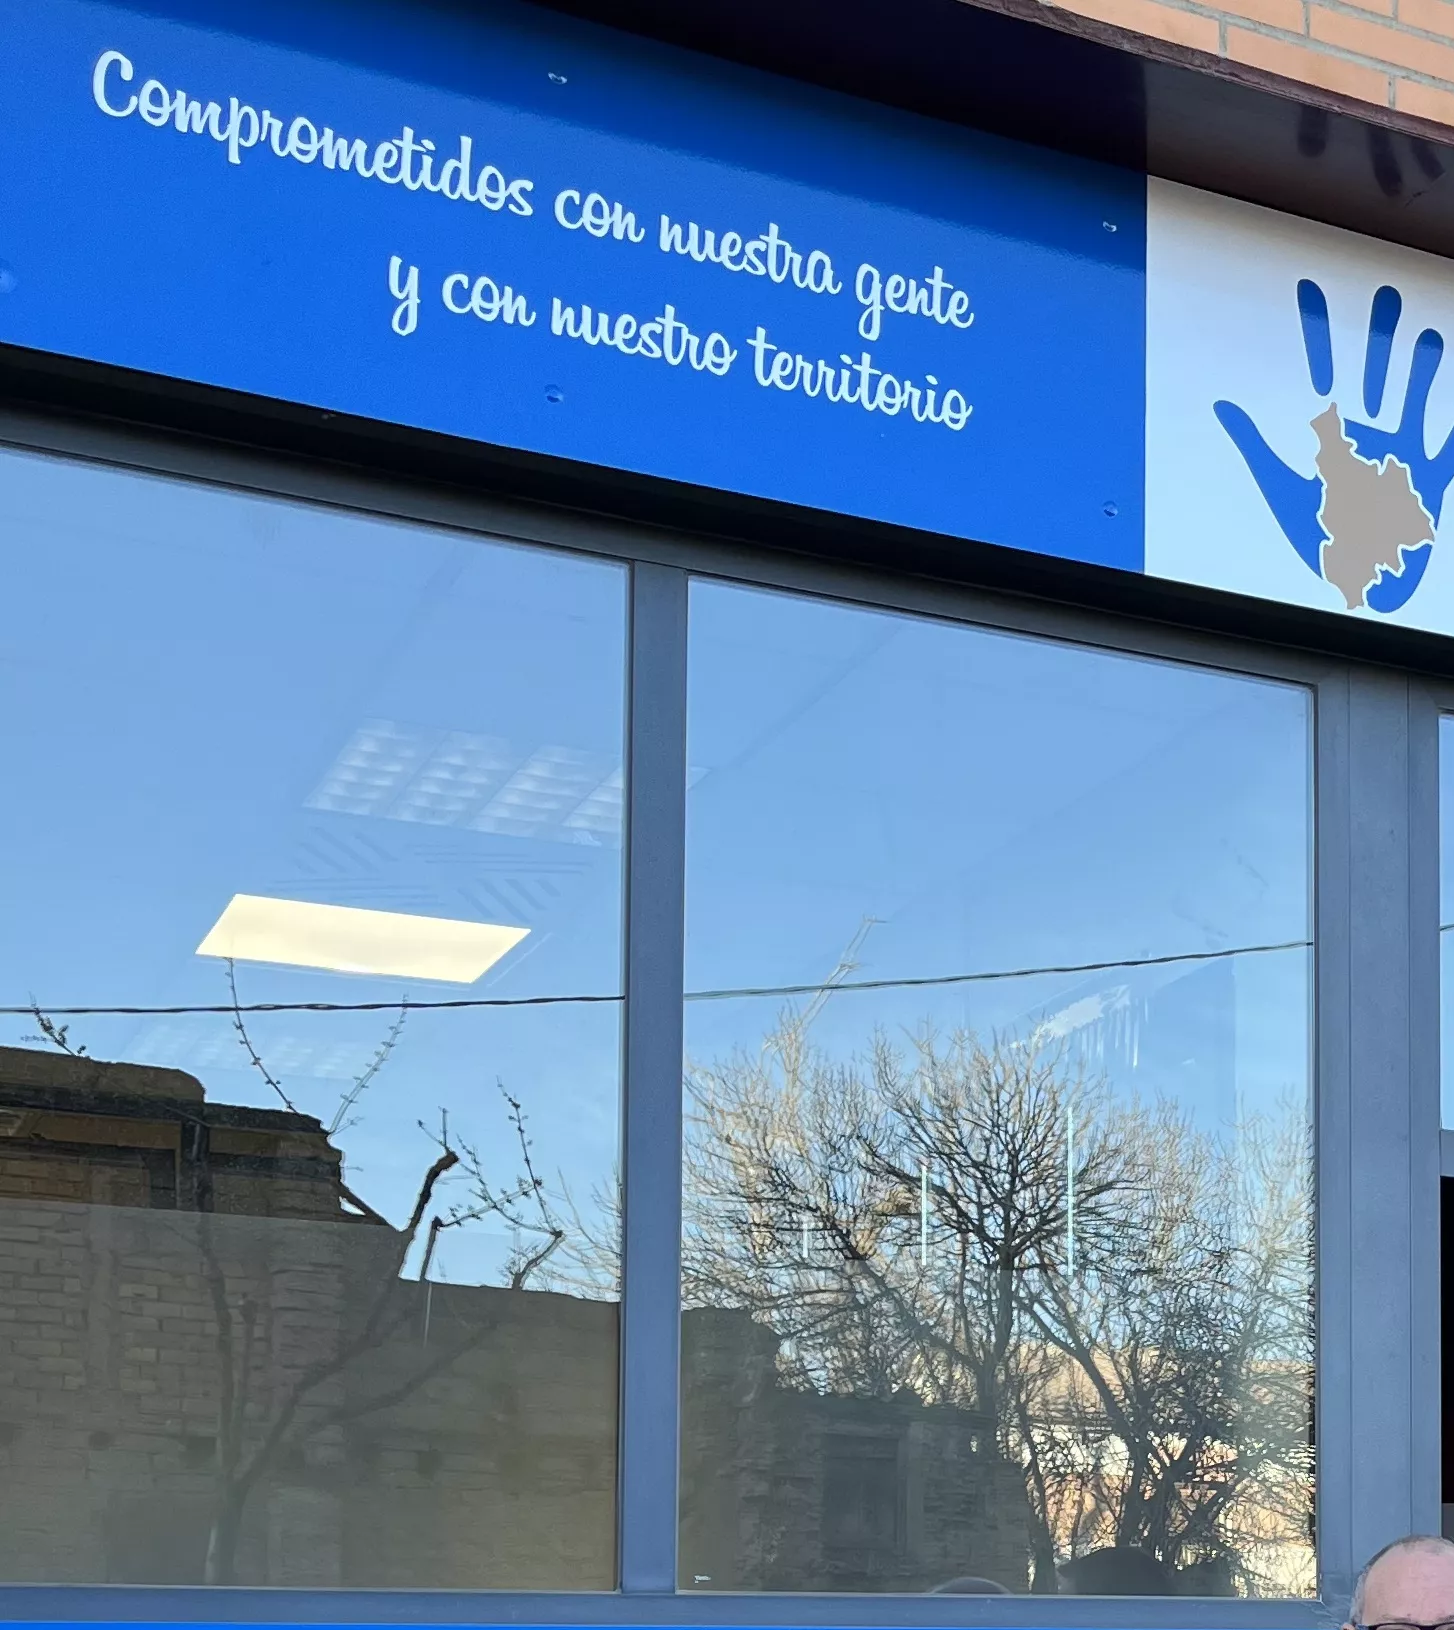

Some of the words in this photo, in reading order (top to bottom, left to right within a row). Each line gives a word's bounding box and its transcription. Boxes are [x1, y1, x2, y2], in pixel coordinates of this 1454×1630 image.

[92, 50, 535, 216] Comprometidos
[554, 189, 646, 243] con
[659, 214, 843, 296] nuestra
[855, 263, 975, 341] gente
[389, 256, 421, 336] y
[442, 273, 537, 327] con
[551, 298, 738, 376] nuestro
[747, 326, 973, 431] territorio
